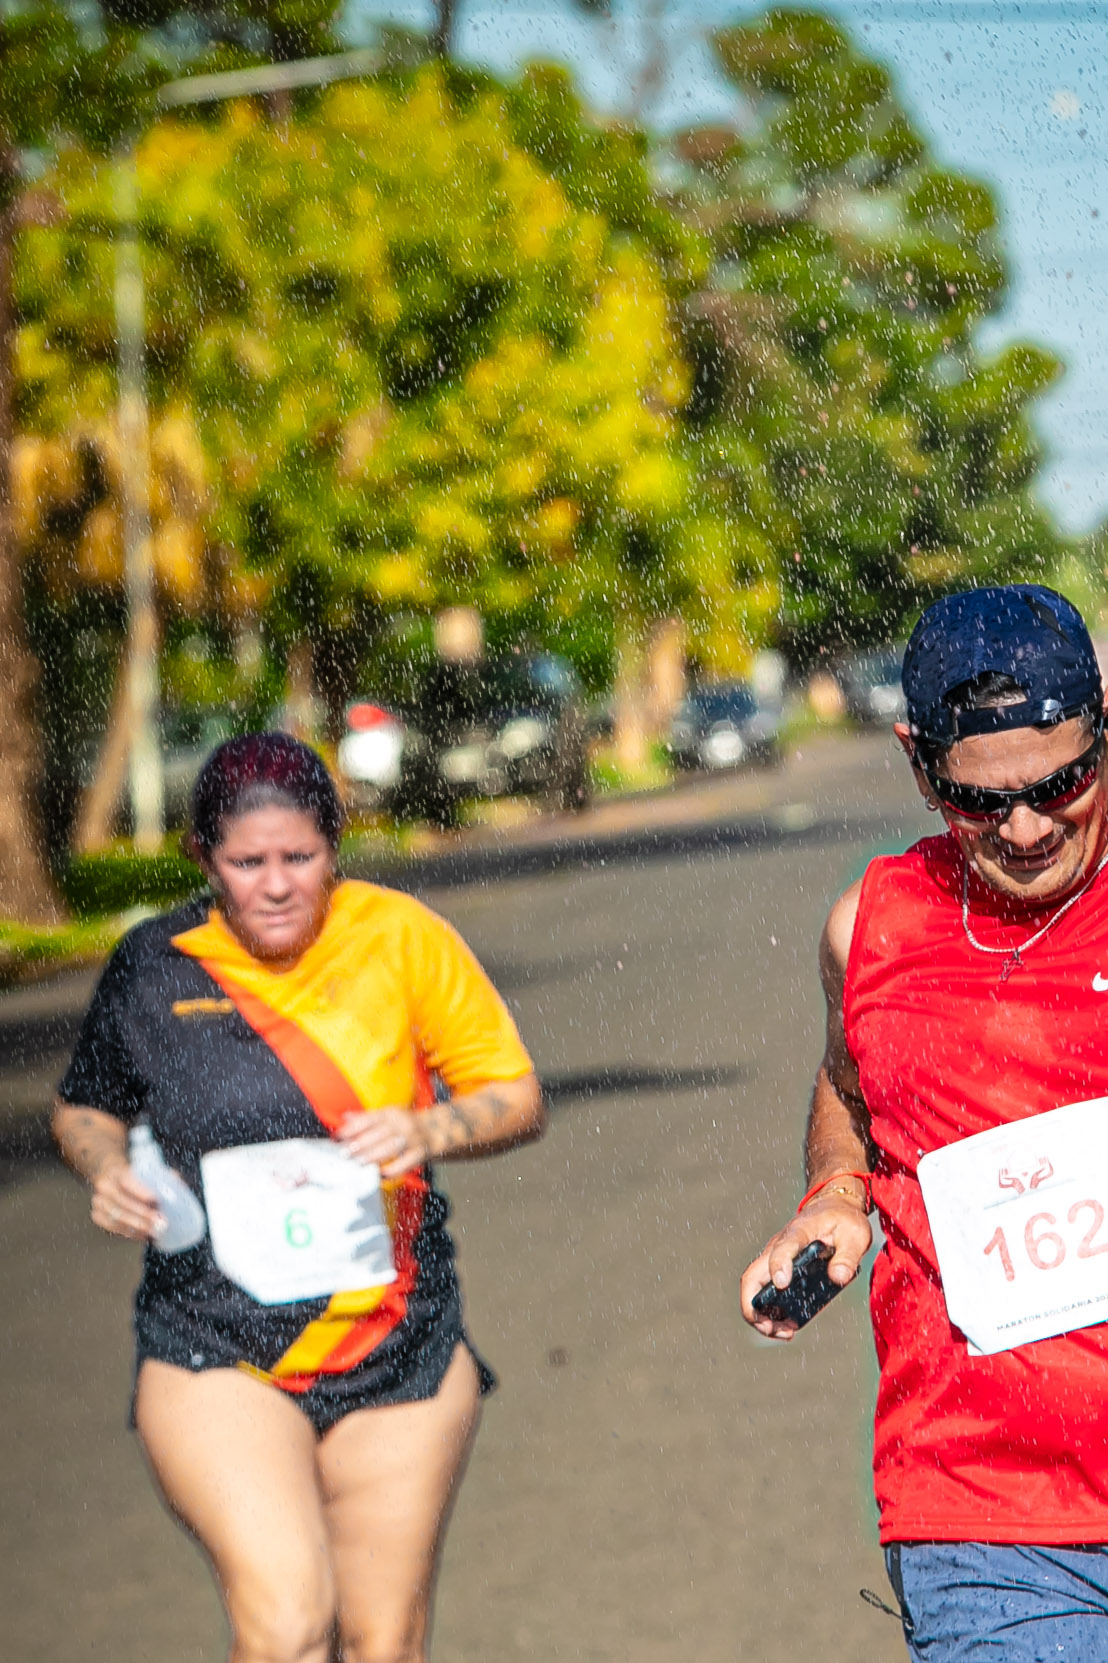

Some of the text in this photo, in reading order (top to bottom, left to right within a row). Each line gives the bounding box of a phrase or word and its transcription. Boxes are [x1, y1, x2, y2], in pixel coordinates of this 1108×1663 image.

[284, 1208, 313, 1248] 6
[996, 1314, 1041, 1331] MARATON
[1043, 1299, 1093, 1319] SOLIDARIA
